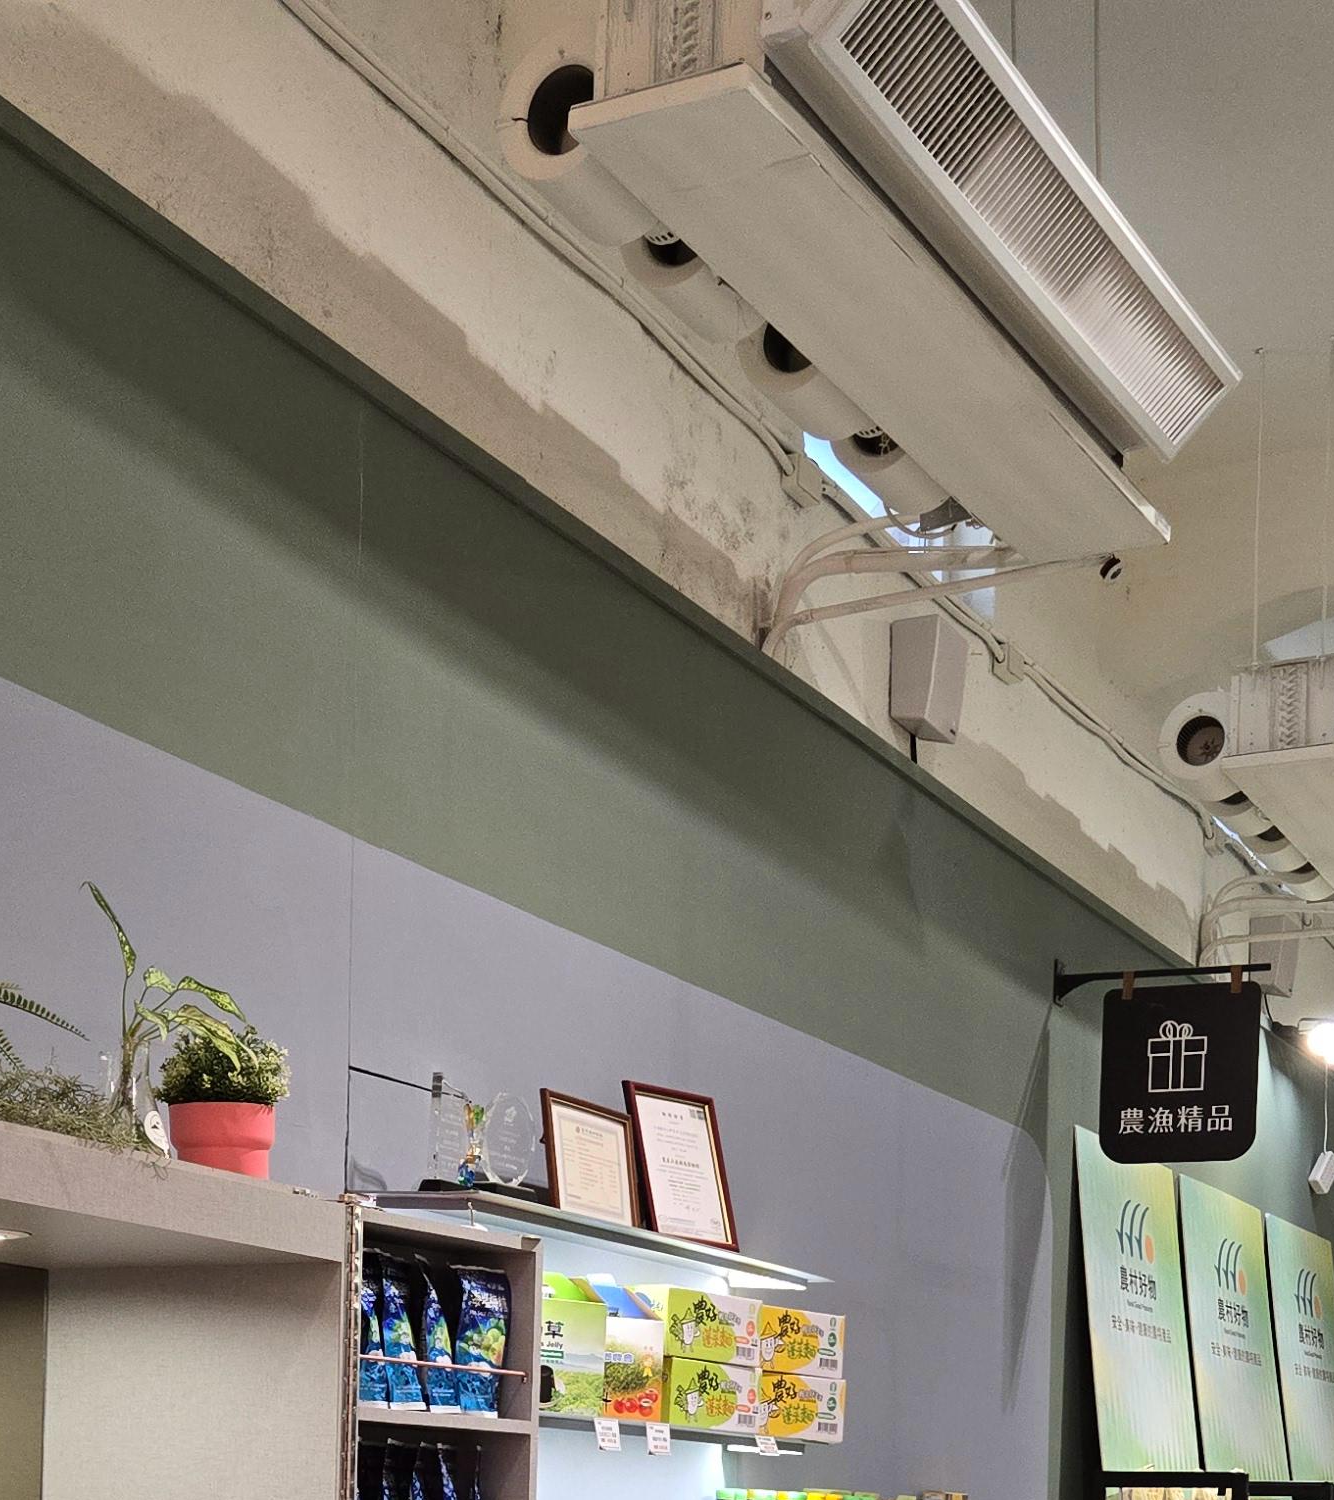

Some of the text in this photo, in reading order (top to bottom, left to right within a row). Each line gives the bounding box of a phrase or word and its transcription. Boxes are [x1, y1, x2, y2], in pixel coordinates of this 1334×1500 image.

[1118, 1104, 1233, 1135] 農漁精品
[546, 1342, 564, 1350] Jelly
